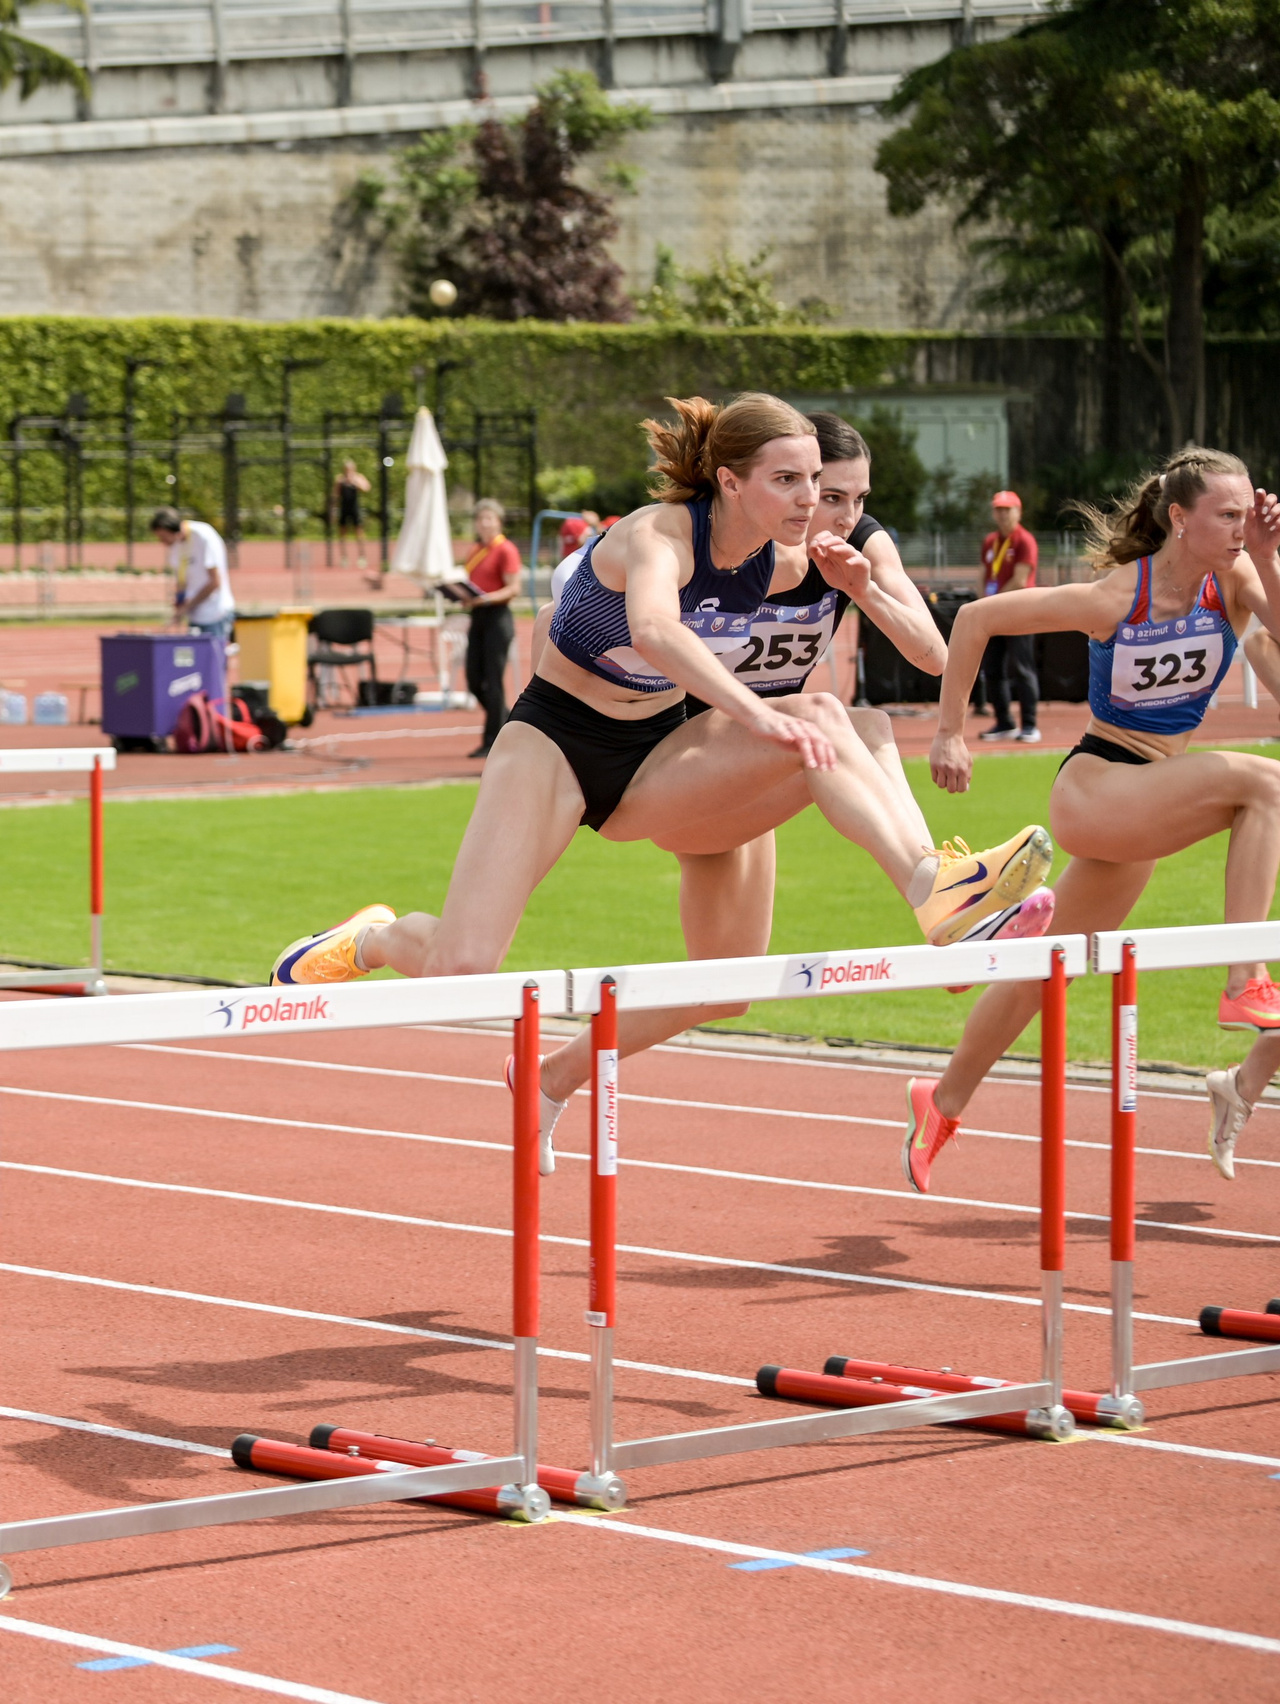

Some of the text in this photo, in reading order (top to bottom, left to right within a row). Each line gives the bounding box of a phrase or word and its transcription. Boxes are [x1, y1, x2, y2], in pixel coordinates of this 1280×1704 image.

[1137, 625, 1169, 638] azimut
[734, 632, 822, 674] 253
[1131, 649, 1207, 692] 323
[820, 957, 892, 989] polanik
[241, 994, 329, 1030] polanik
